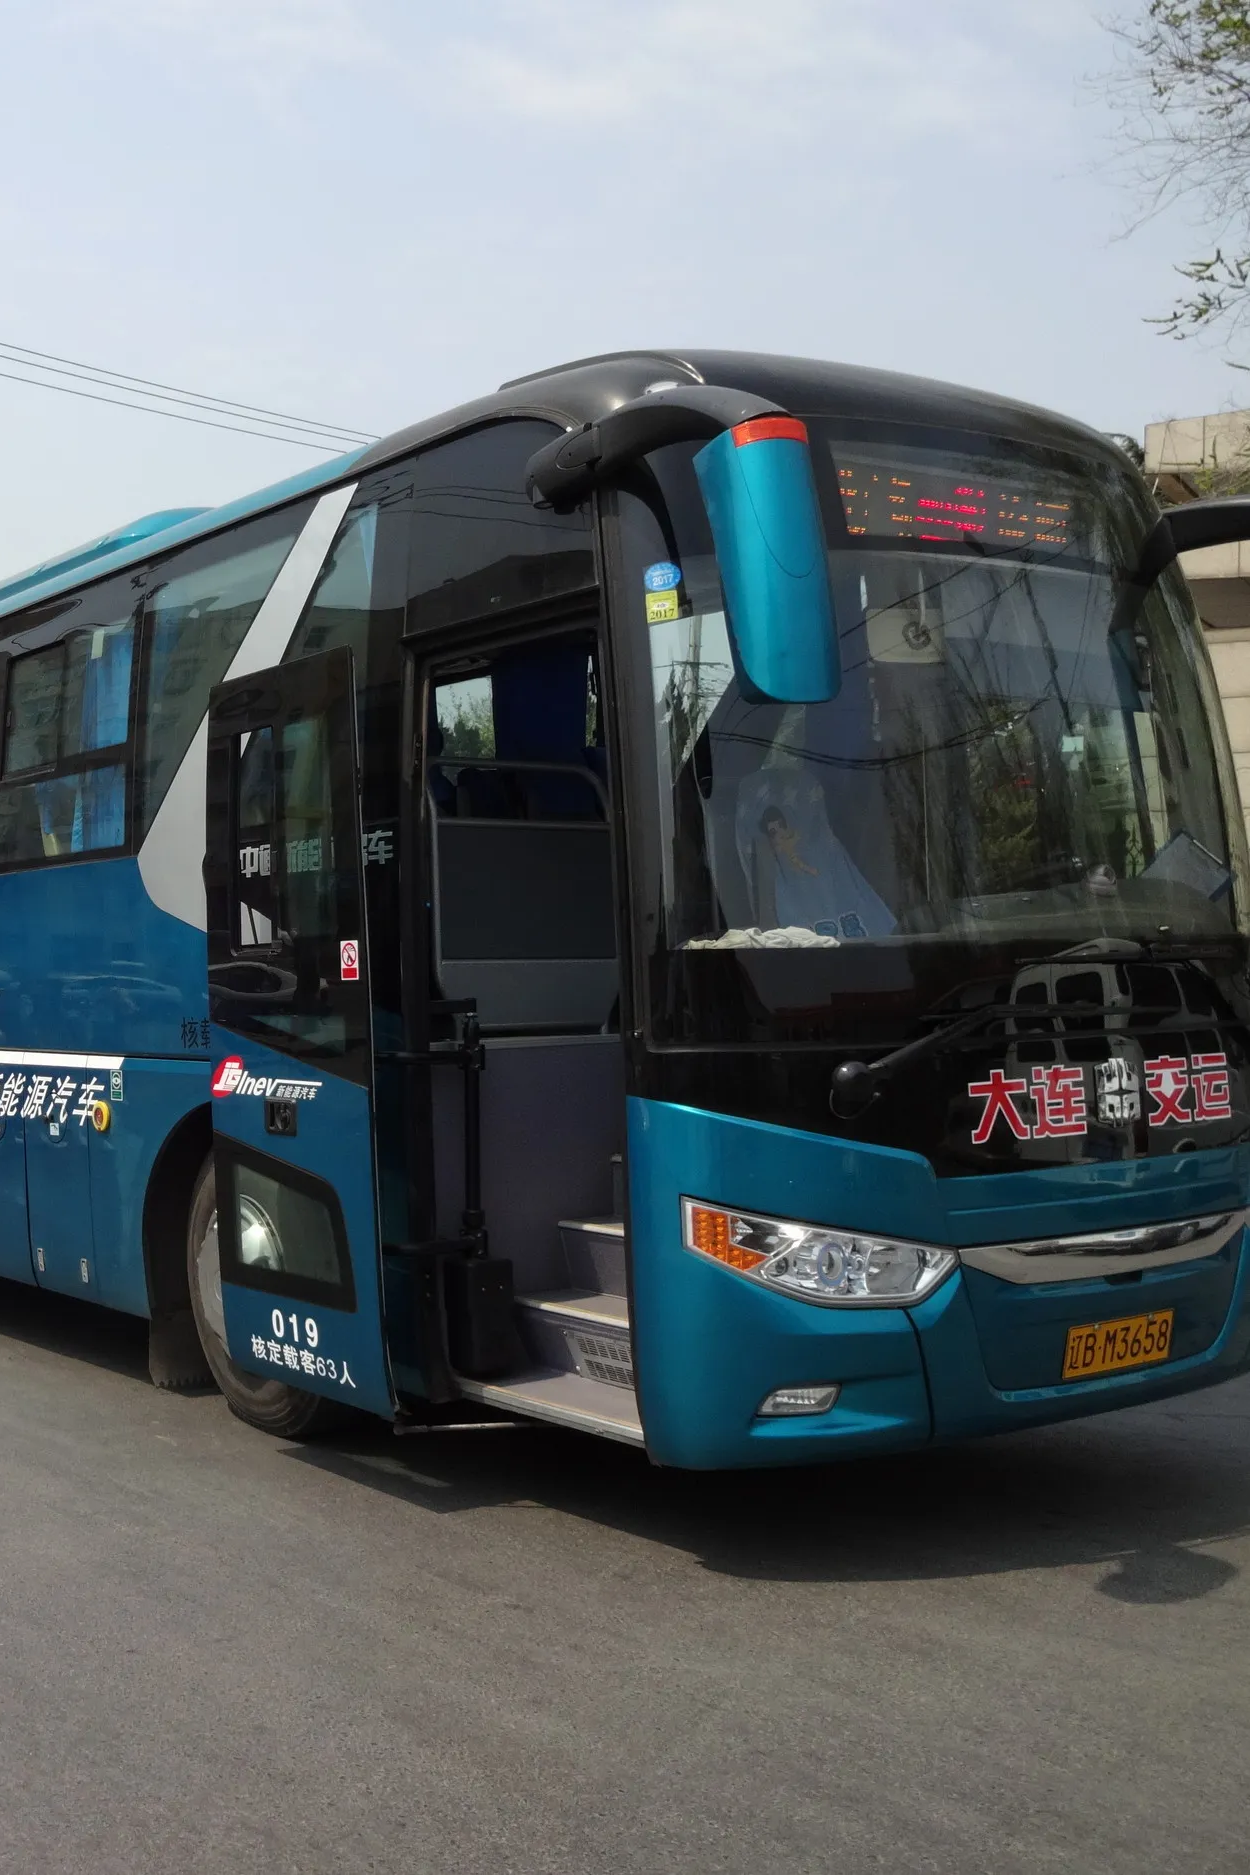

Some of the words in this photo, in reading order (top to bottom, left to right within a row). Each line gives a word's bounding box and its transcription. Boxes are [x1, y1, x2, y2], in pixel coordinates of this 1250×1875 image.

[650, 608, 675, 620] 2017
[275, 1085, 318, 1100] 新能源汽车
[968, 1064, 1088, 1144] 大连
[1143, 1053, 1232, 1126] 交运
[271, 1308, 319, 1348] 019
[251, 1333, 357, 1389] 核定载客63人
